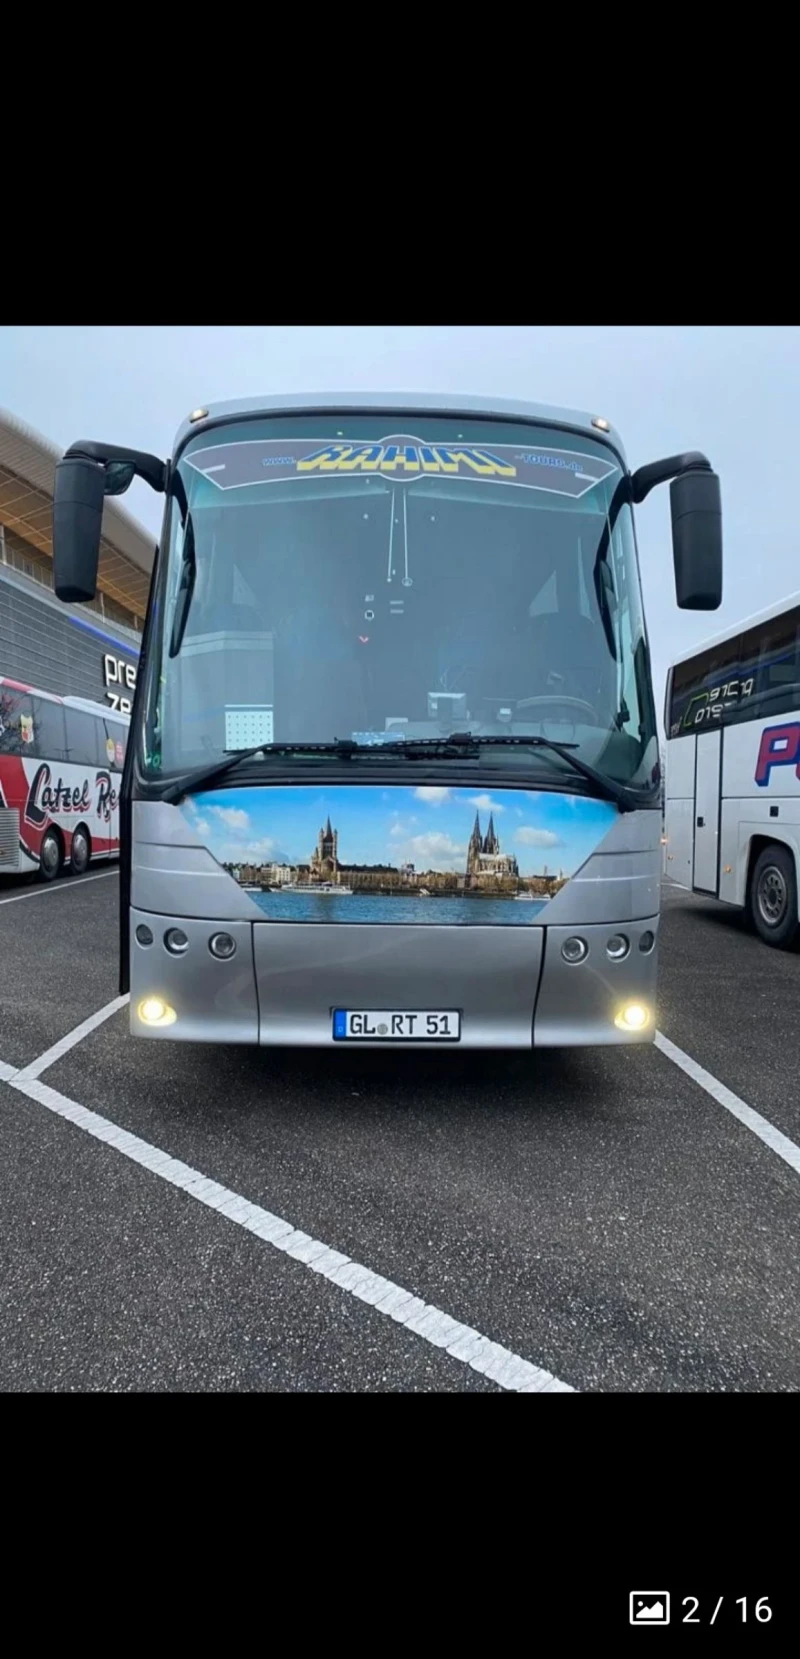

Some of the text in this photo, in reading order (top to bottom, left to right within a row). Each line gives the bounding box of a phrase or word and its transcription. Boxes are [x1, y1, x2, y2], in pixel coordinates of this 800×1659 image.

[297, 444, 517, 477] RAHIMI
[104, 653, 137, 689] pre
[350, 1014, 451, 1035] GL RT 51
